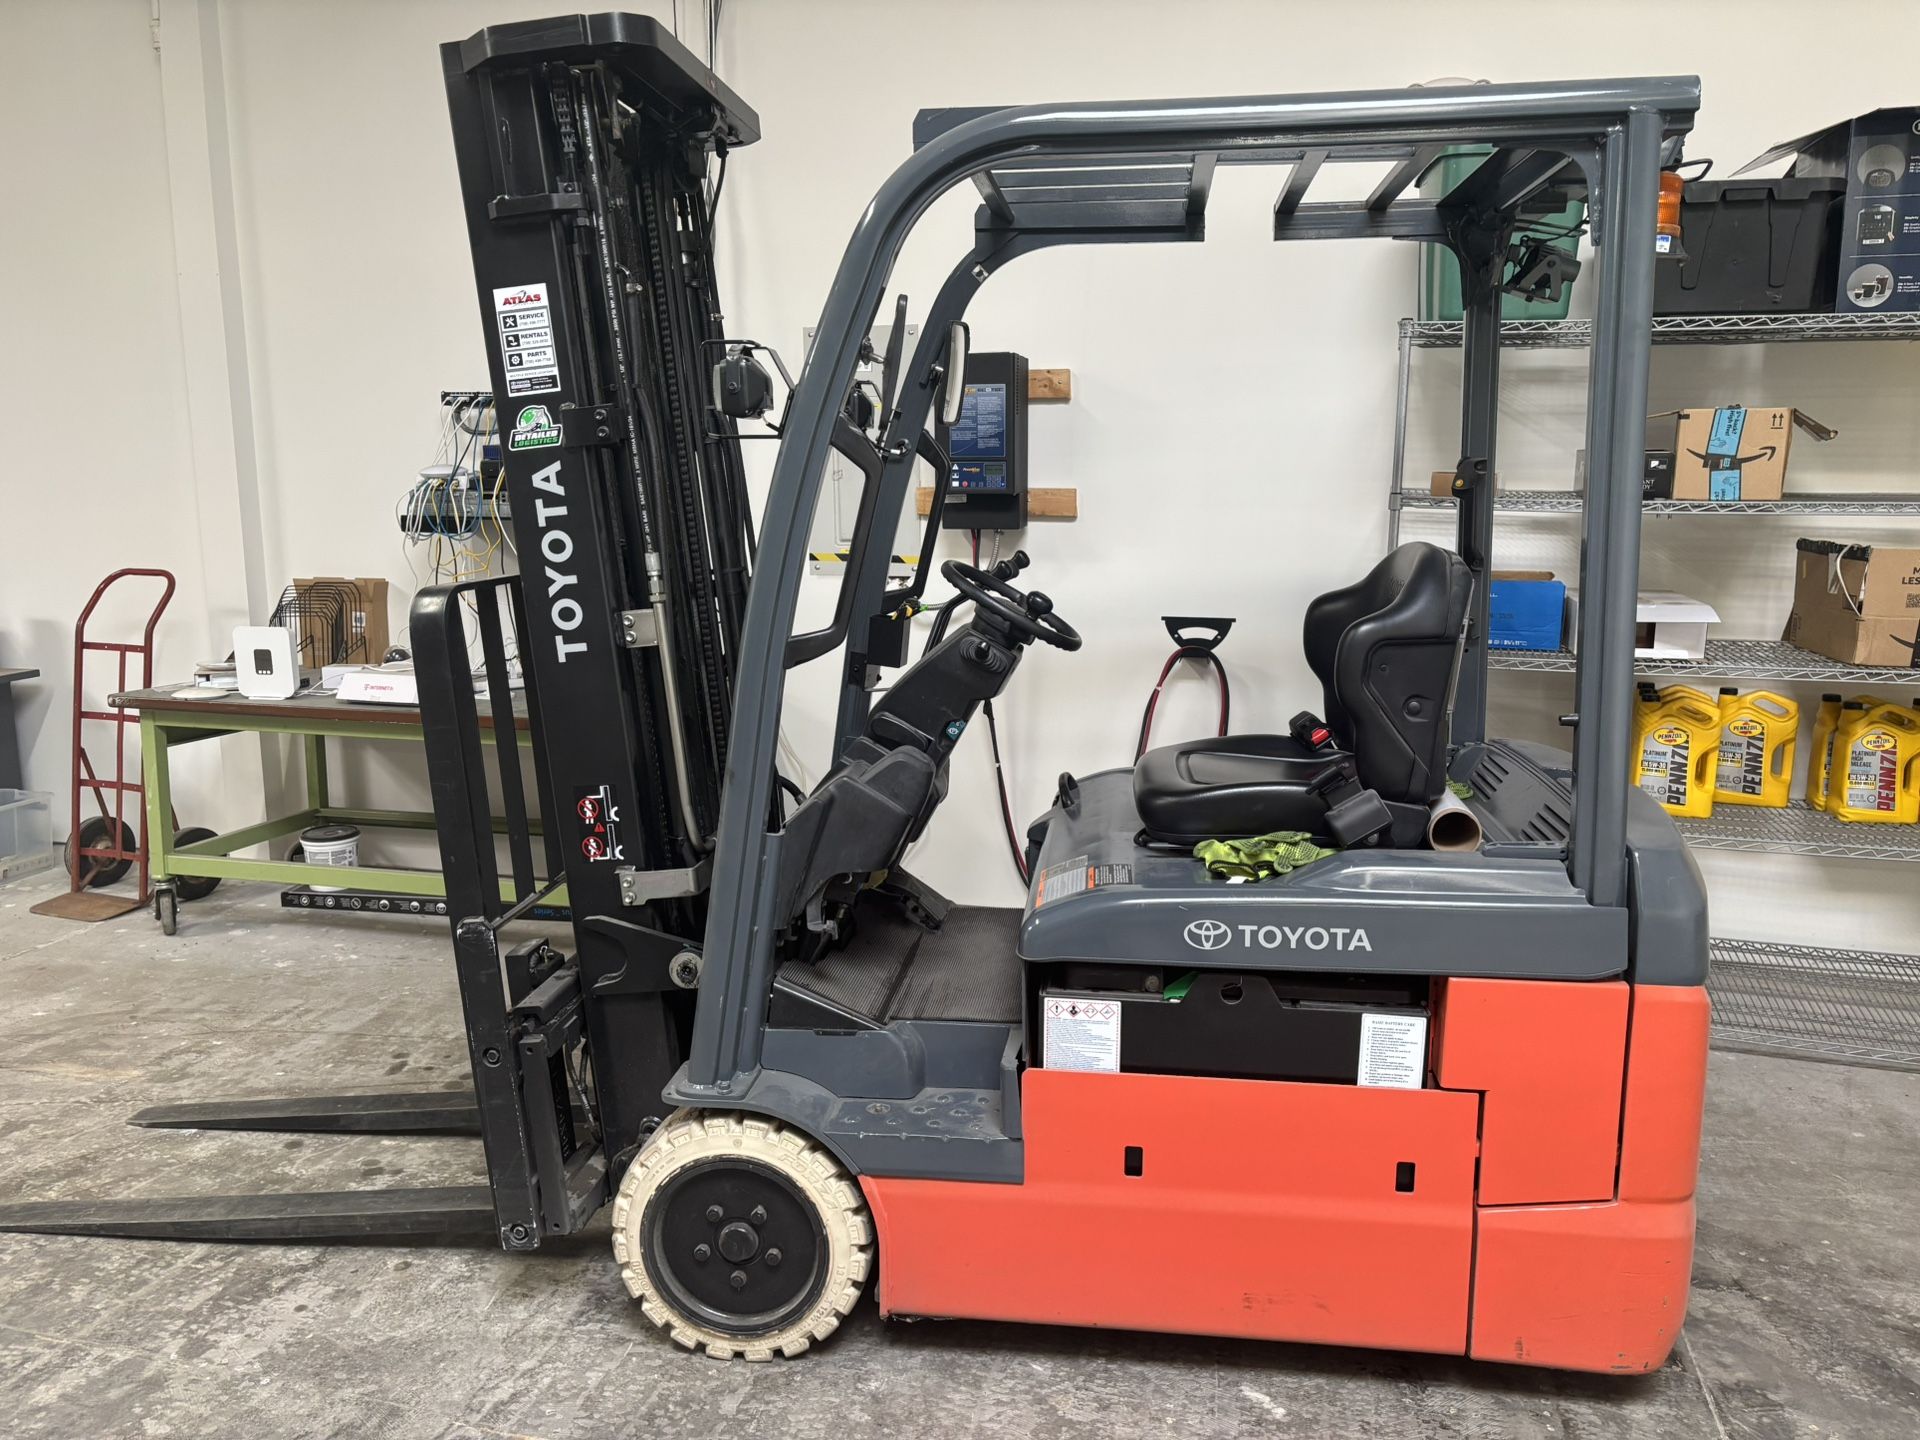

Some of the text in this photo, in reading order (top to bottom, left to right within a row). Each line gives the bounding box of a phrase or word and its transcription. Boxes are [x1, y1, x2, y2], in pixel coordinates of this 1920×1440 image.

[503, 294, 542, 306] ATLAS
[519, 312, 545, 320] SERVICE
[520, 331, 548, 340] RENTALS
[527, 350, 547, 358] PARTS
[515, 430, 558, 441] DETAILED
[514, 437, 559, 447] LOGISTICS
[531, 460, 588, 663] TOYOTA
[1867, 738, 1891, 746] PENNZOIL
[1648, 761, 1666, 769] 5W-30
[1238, 925, 1372, 951] TOYOTA
[779, 1153, 838, 1210] FORZA
